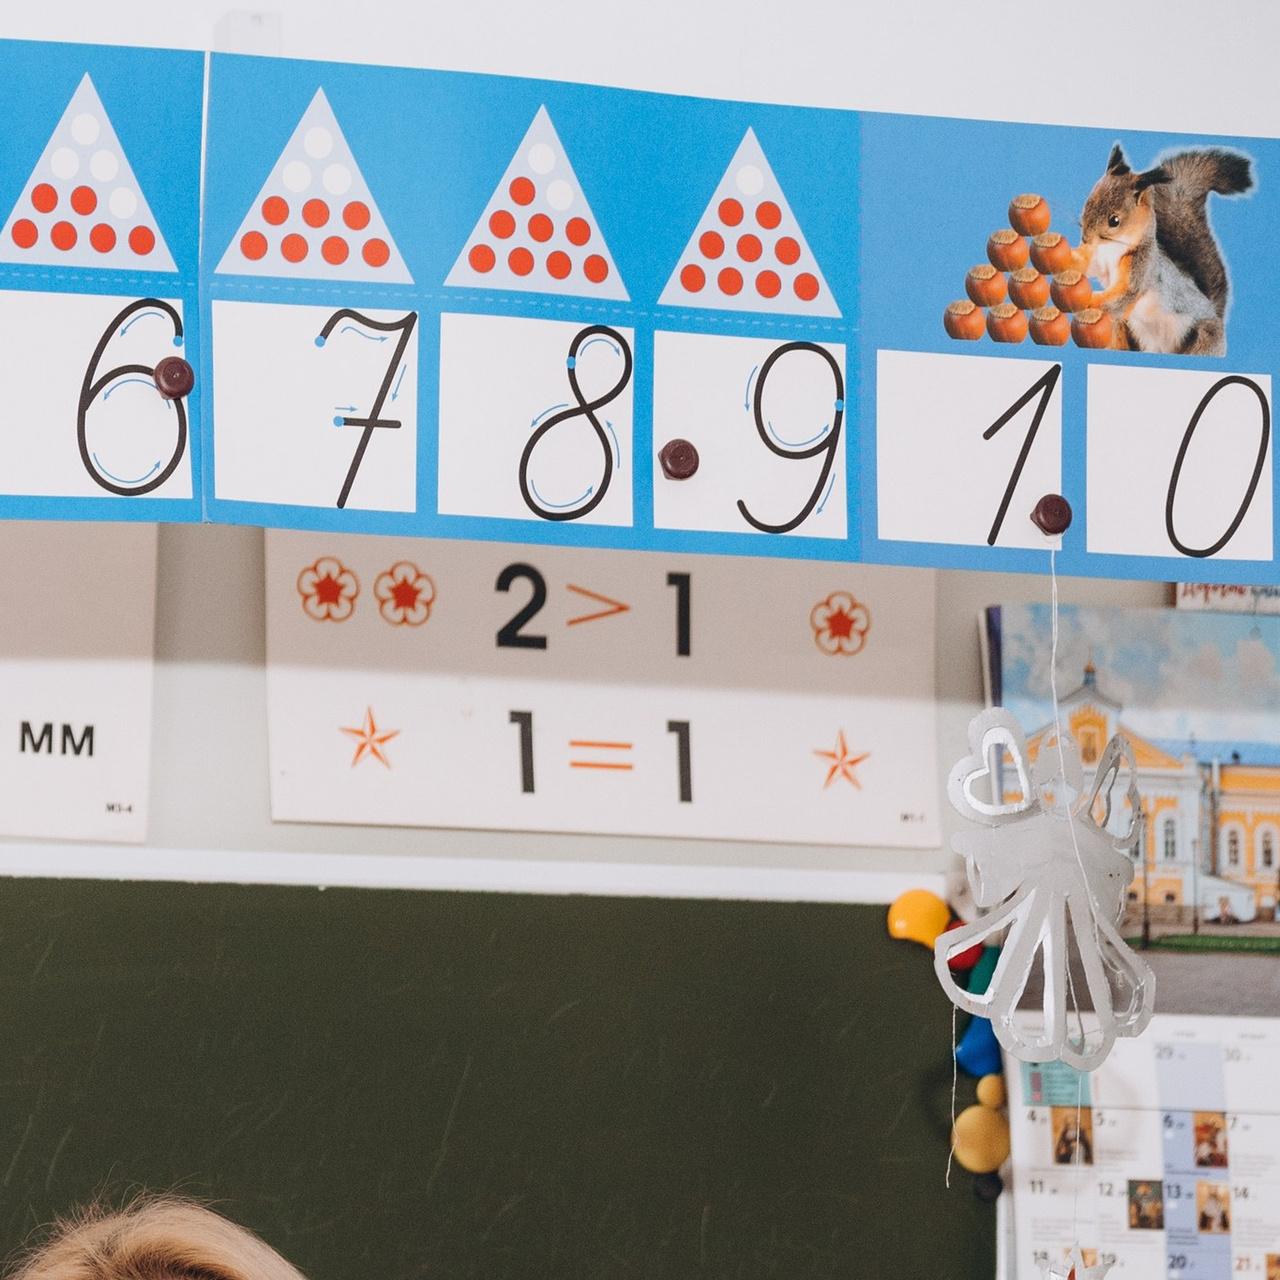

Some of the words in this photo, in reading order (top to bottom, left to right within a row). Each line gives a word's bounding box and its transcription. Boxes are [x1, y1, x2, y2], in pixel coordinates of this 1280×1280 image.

[77, 299, 188, 496] 6
[317, 309, 418, 508] 7
[519, 326, 632, 521] 8
[737, 342, 844, 534] 9
[494, 562, 548, 651] 2
[667, 571, 692, 658] 1
[20, 721, 96, 758] мм
[508, 710, 536, 795] 1
[667, 720, 693, 803] 1
